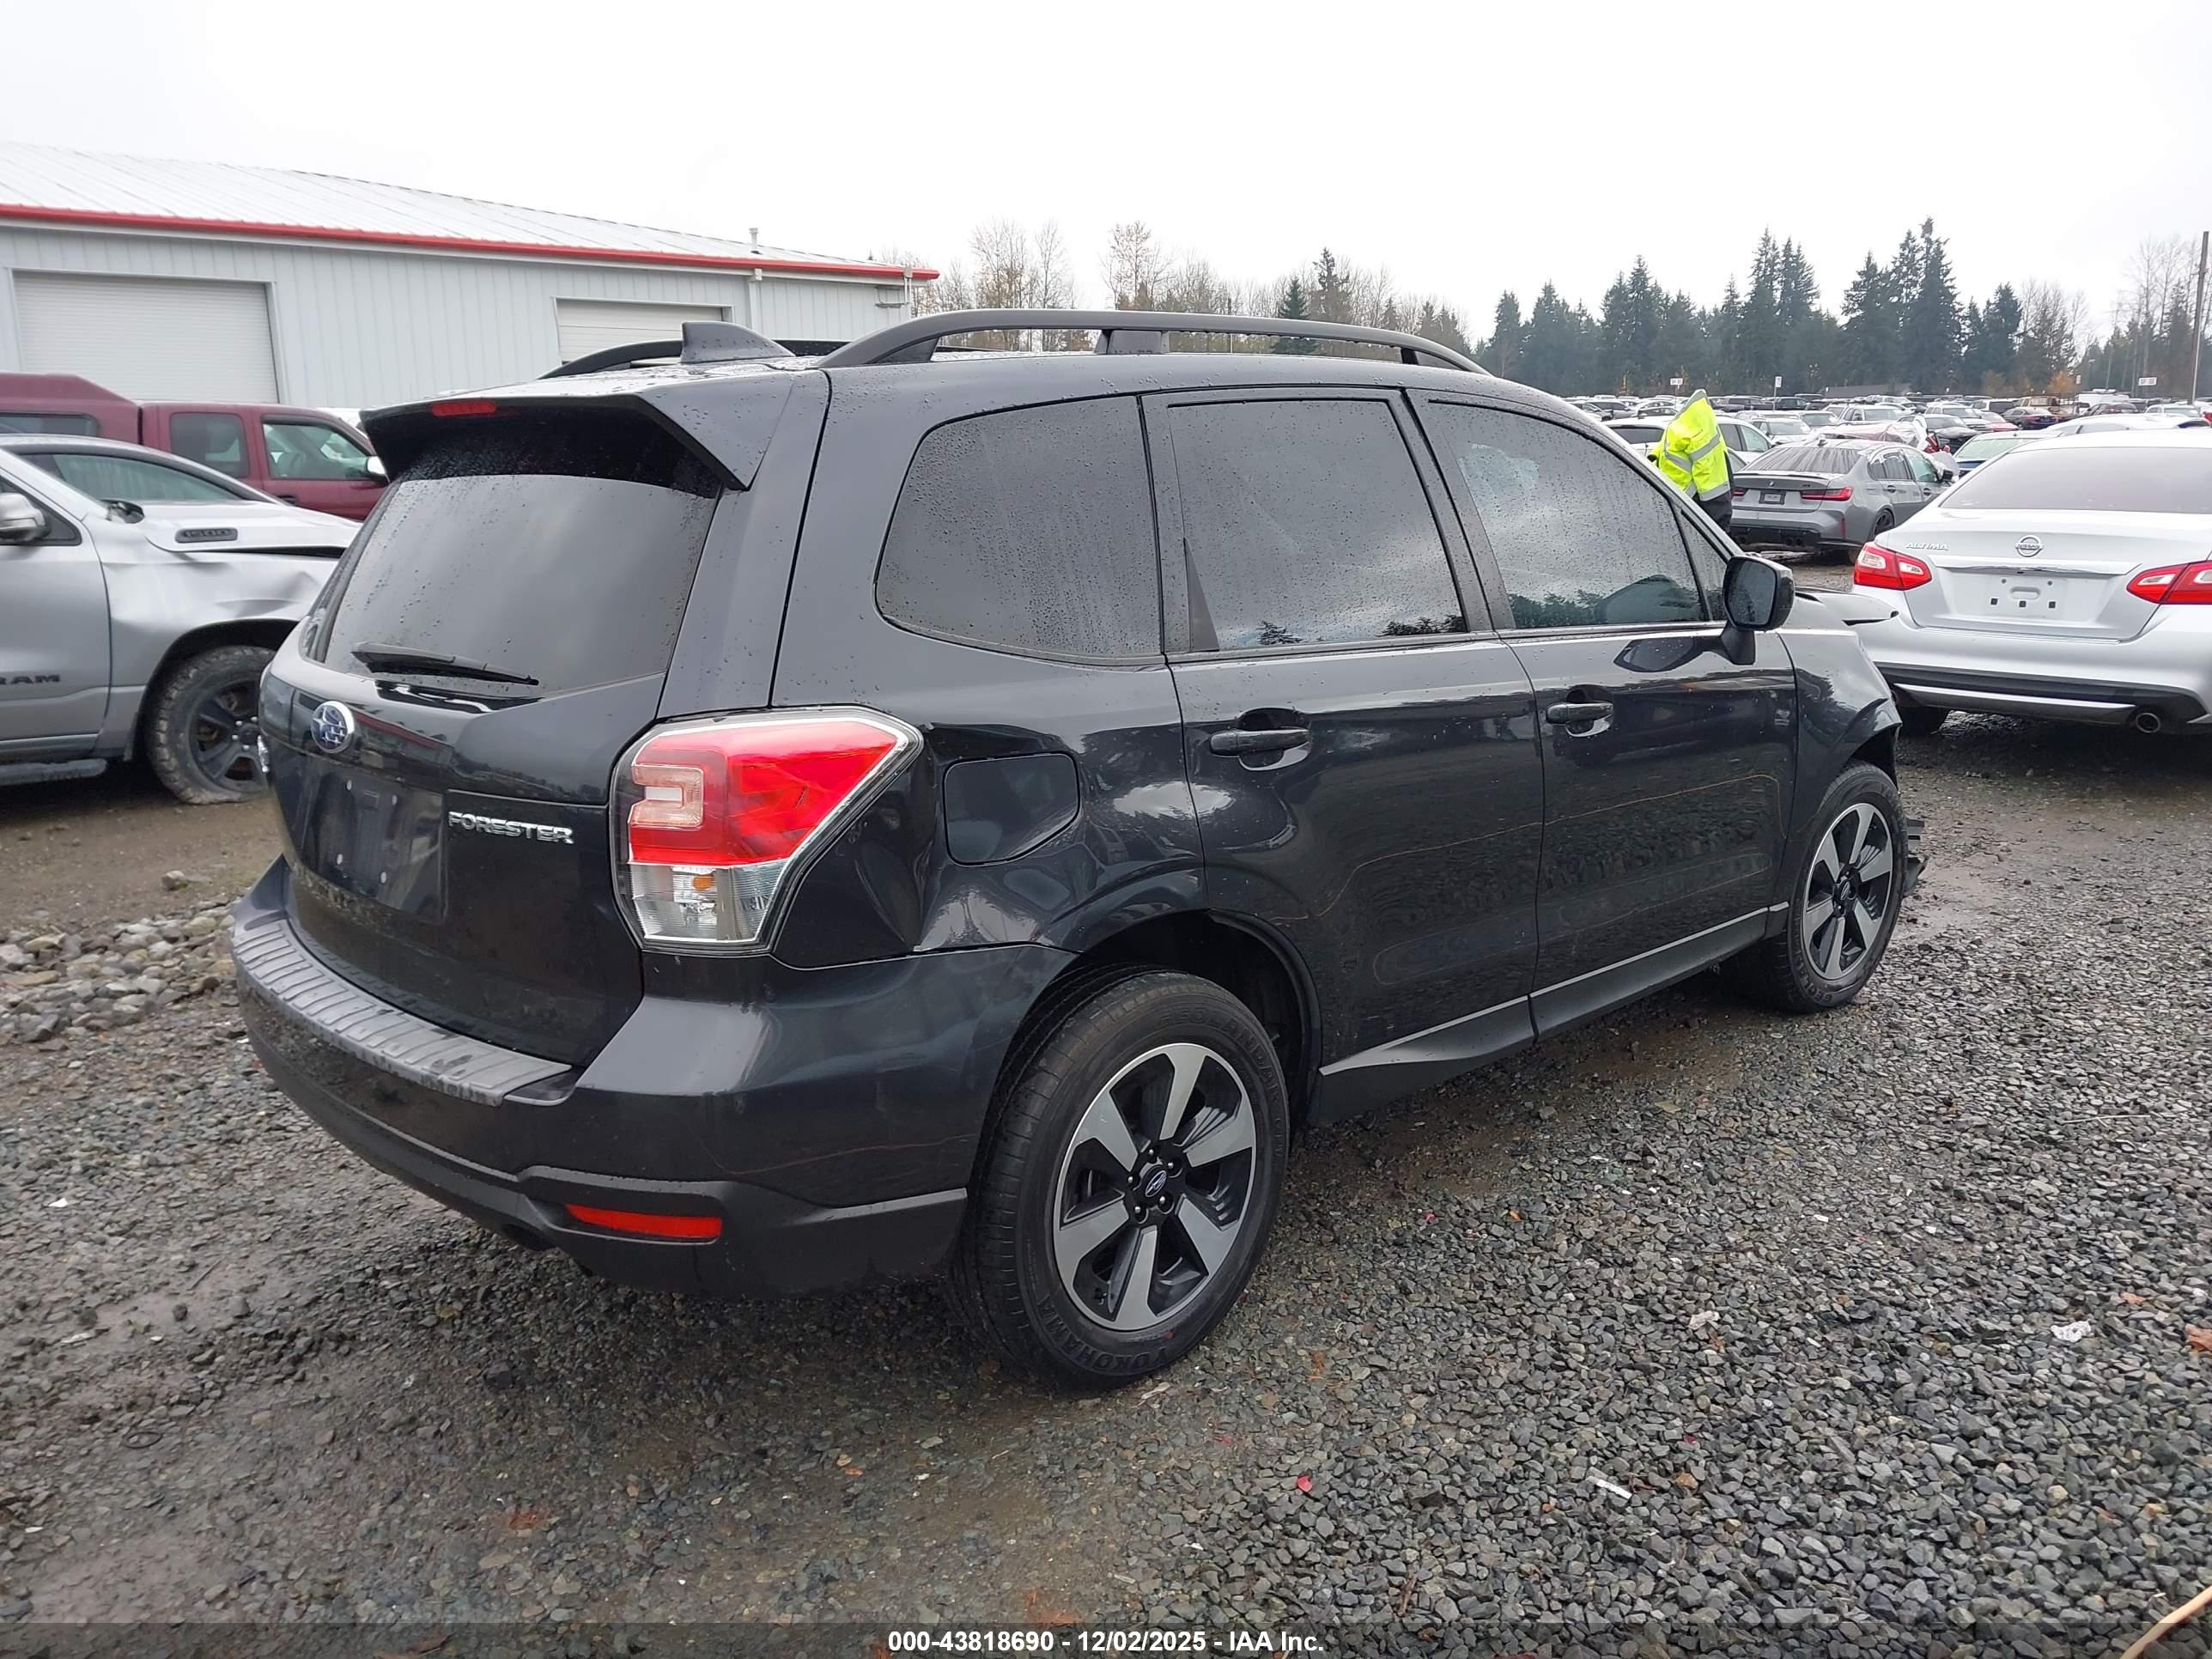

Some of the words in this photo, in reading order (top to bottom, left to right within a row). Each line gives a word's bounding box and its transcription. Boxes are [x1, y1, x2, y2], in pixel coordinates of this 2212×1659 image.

[1905, 542, 1949, 551] ALTIMA
[448, 811, 574, 844] FORESTER
[1036, 1293, 1170, 1372] YOKOHAMA
